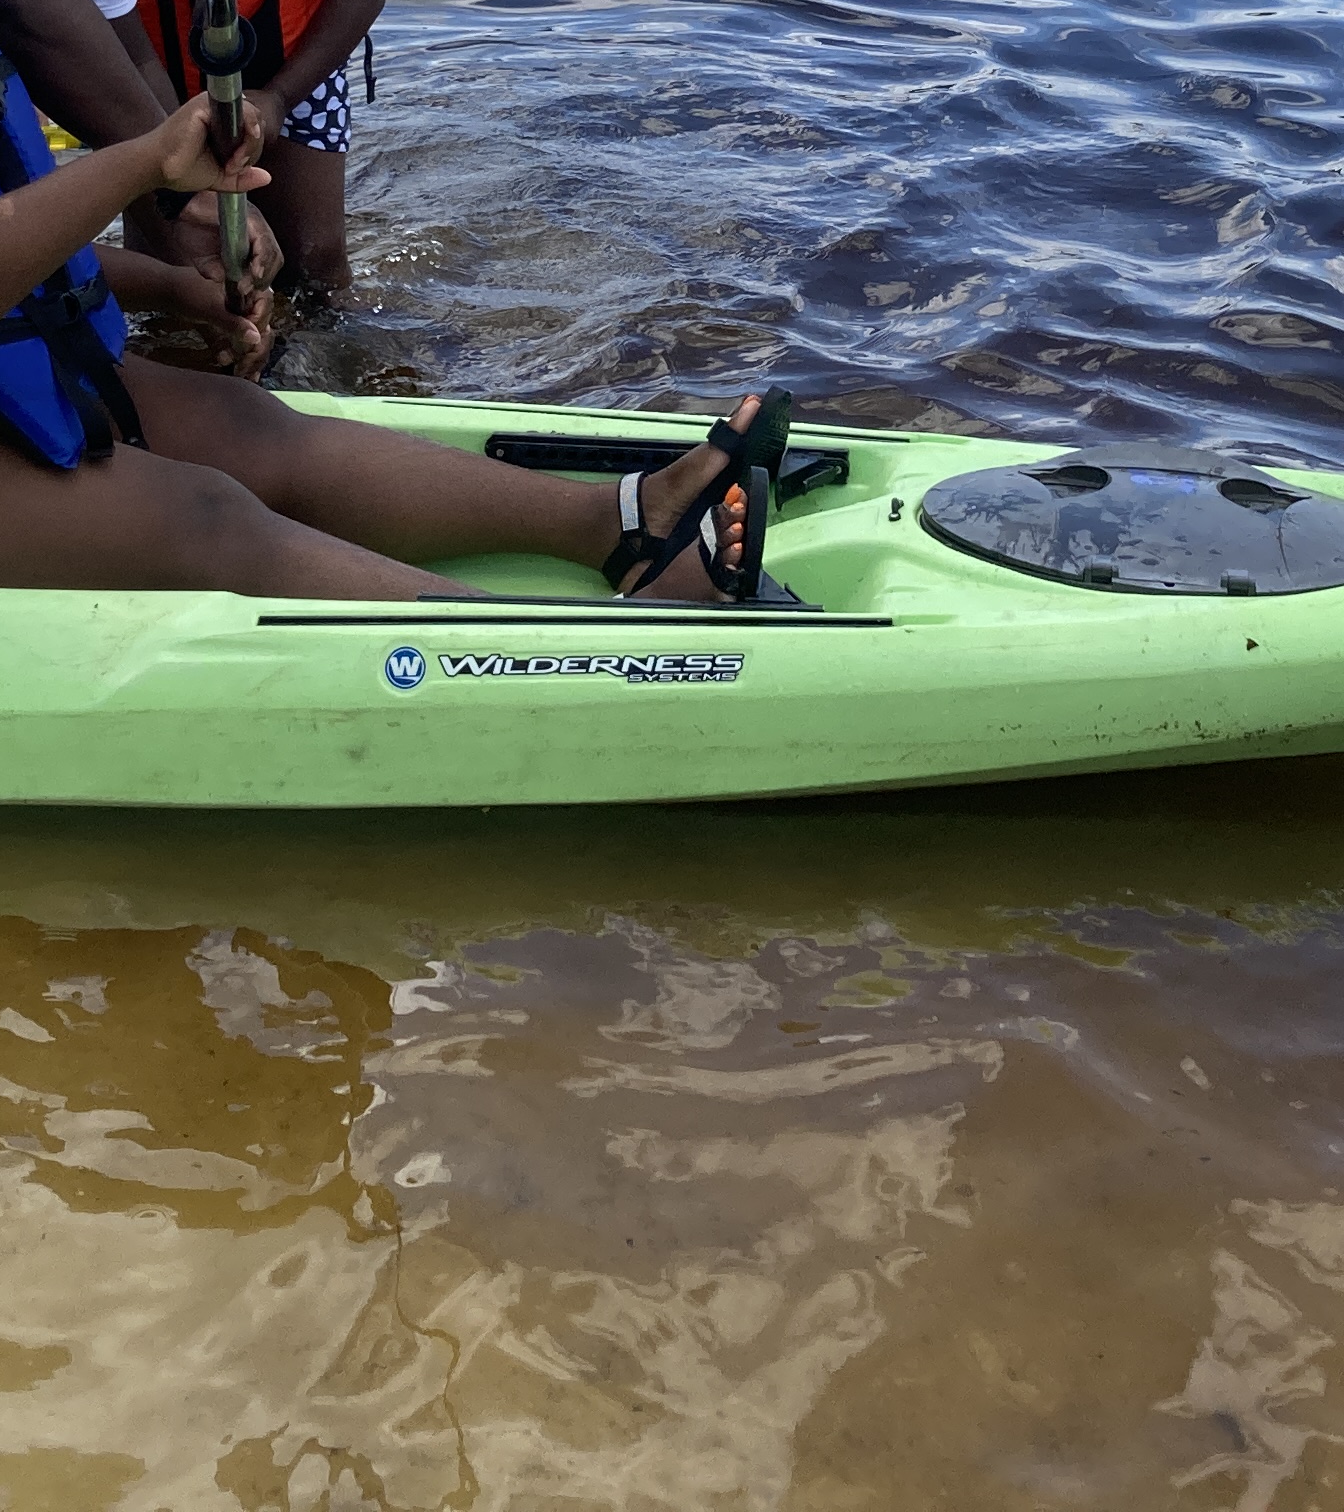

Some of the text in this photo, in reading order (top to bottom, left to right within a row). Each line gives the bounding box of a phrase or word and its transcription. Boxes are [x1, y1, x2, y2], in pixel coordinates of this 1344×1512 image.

[386, 653, 745, 680] W WILDERNESS
[628, 672, 740, 683] SYSTEMS
